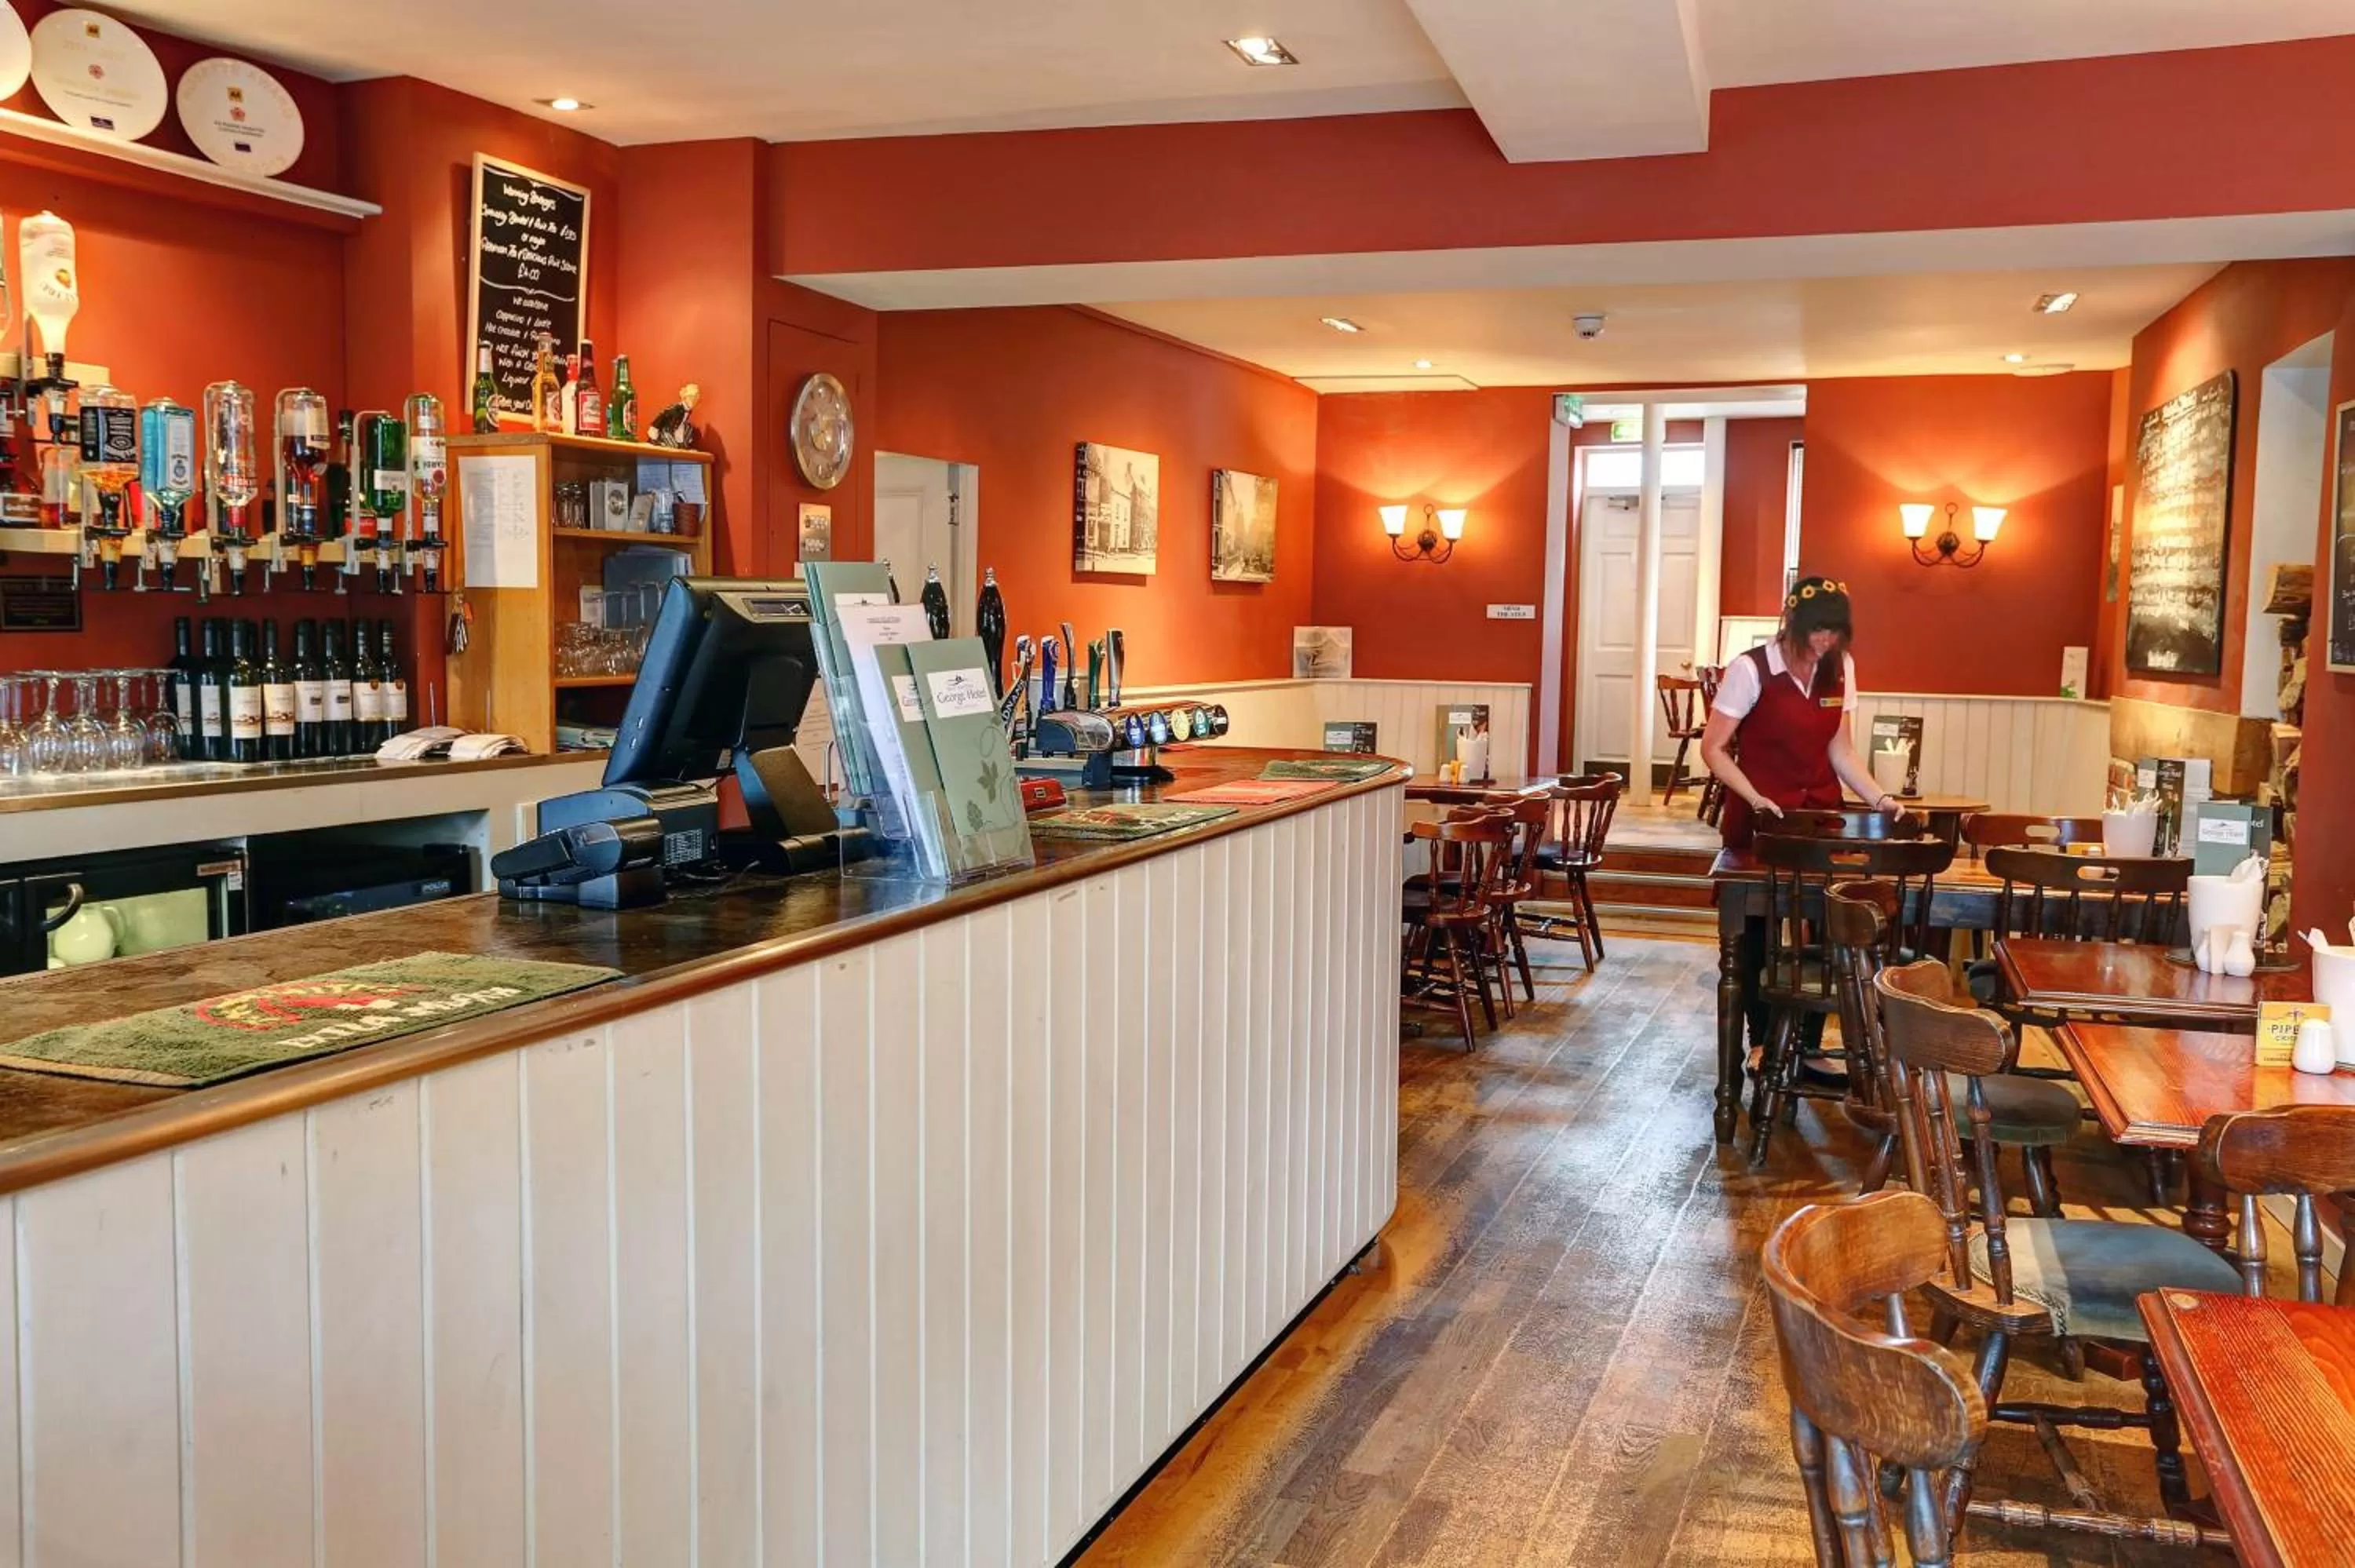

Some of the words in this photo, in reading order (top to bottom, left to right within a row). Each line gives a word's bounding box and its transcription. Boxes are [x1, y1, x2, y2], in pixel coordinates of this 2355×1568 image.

[937, 691, 966, 706] George
[966, 687, 988, 700] Hotel
[2271, 1023, 2301, 1035] PIPE
